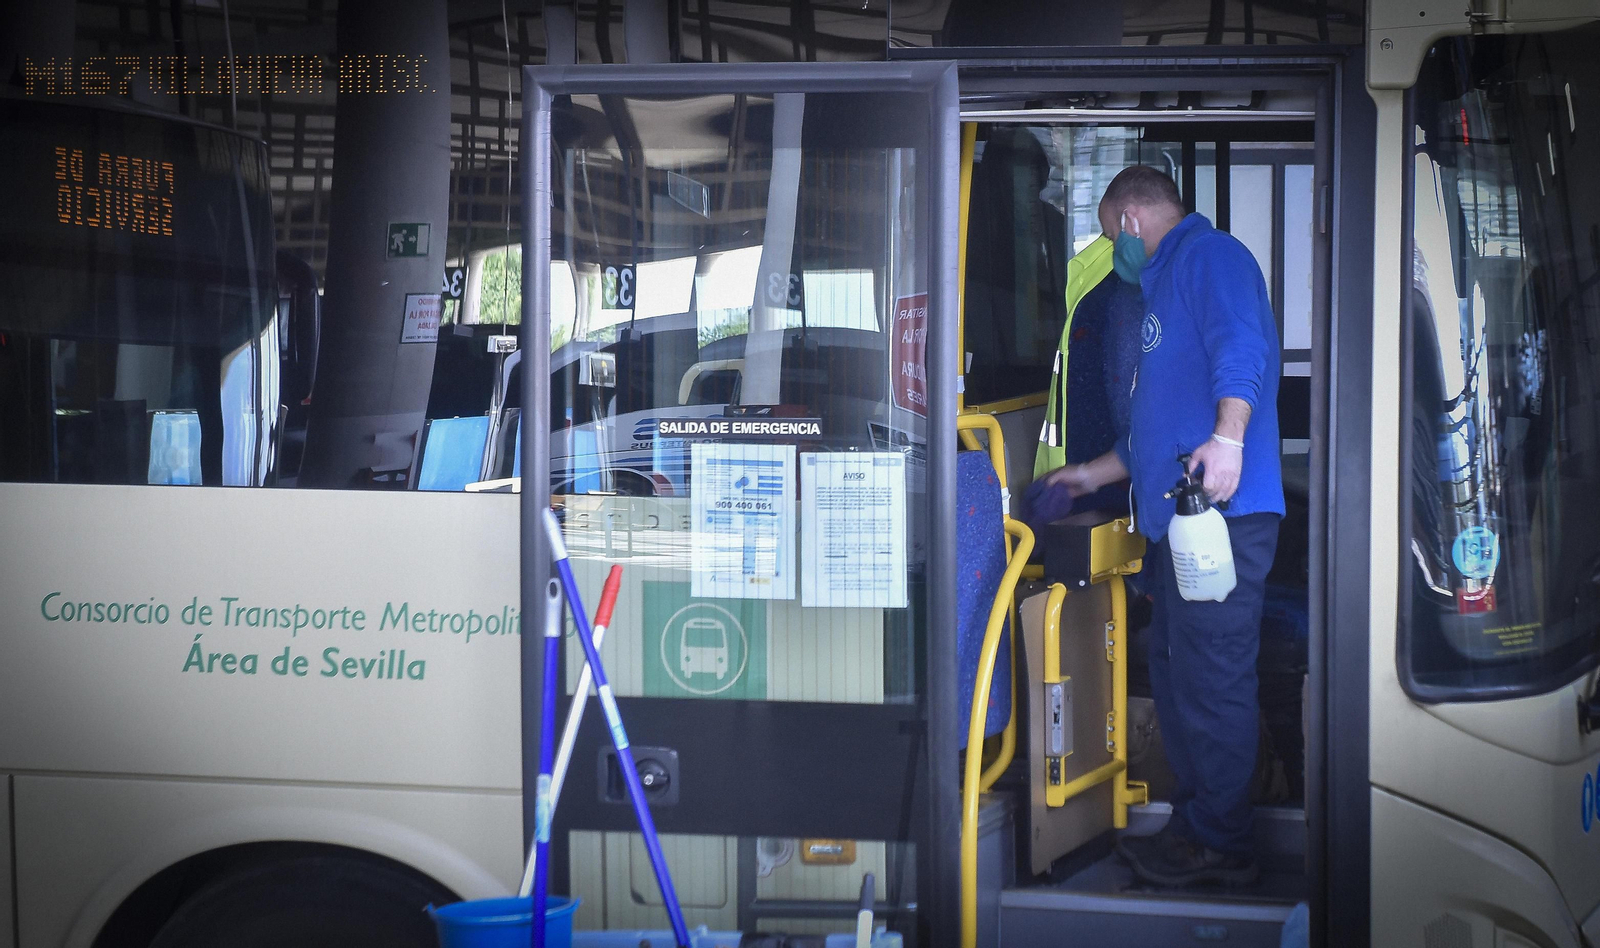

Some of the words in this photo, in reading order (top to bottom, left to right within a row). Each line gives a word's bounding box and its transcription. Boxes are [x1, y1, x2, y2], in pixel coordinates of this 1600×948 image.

[26, 56, 140, 95] M167
[149, 55, 322, 95] VILLANUEVA
[340, 53, 437, 94] ARISC.
[659, 421, 707, 434] SALIDA
[710, 422, 729, 434] DE
[732, 422, 821, 435] EMERGENCIA
[843, 472, 866, 480] AVISO
[715, 500, 733, 509] 900
[735, 501, 753, 509] 400
[755, 502, 772, 510] 061
[41, 592, 170, 625] Consorcio
[181, 596, 213, 626] de
[220, 597, 366, 637] Transporte
[181, 633, 259, 675] Área
[271, 646, 309, 676] de
[320, 647, 426, 680] Sevilla
[1581, 760, 1600, 835] 0
